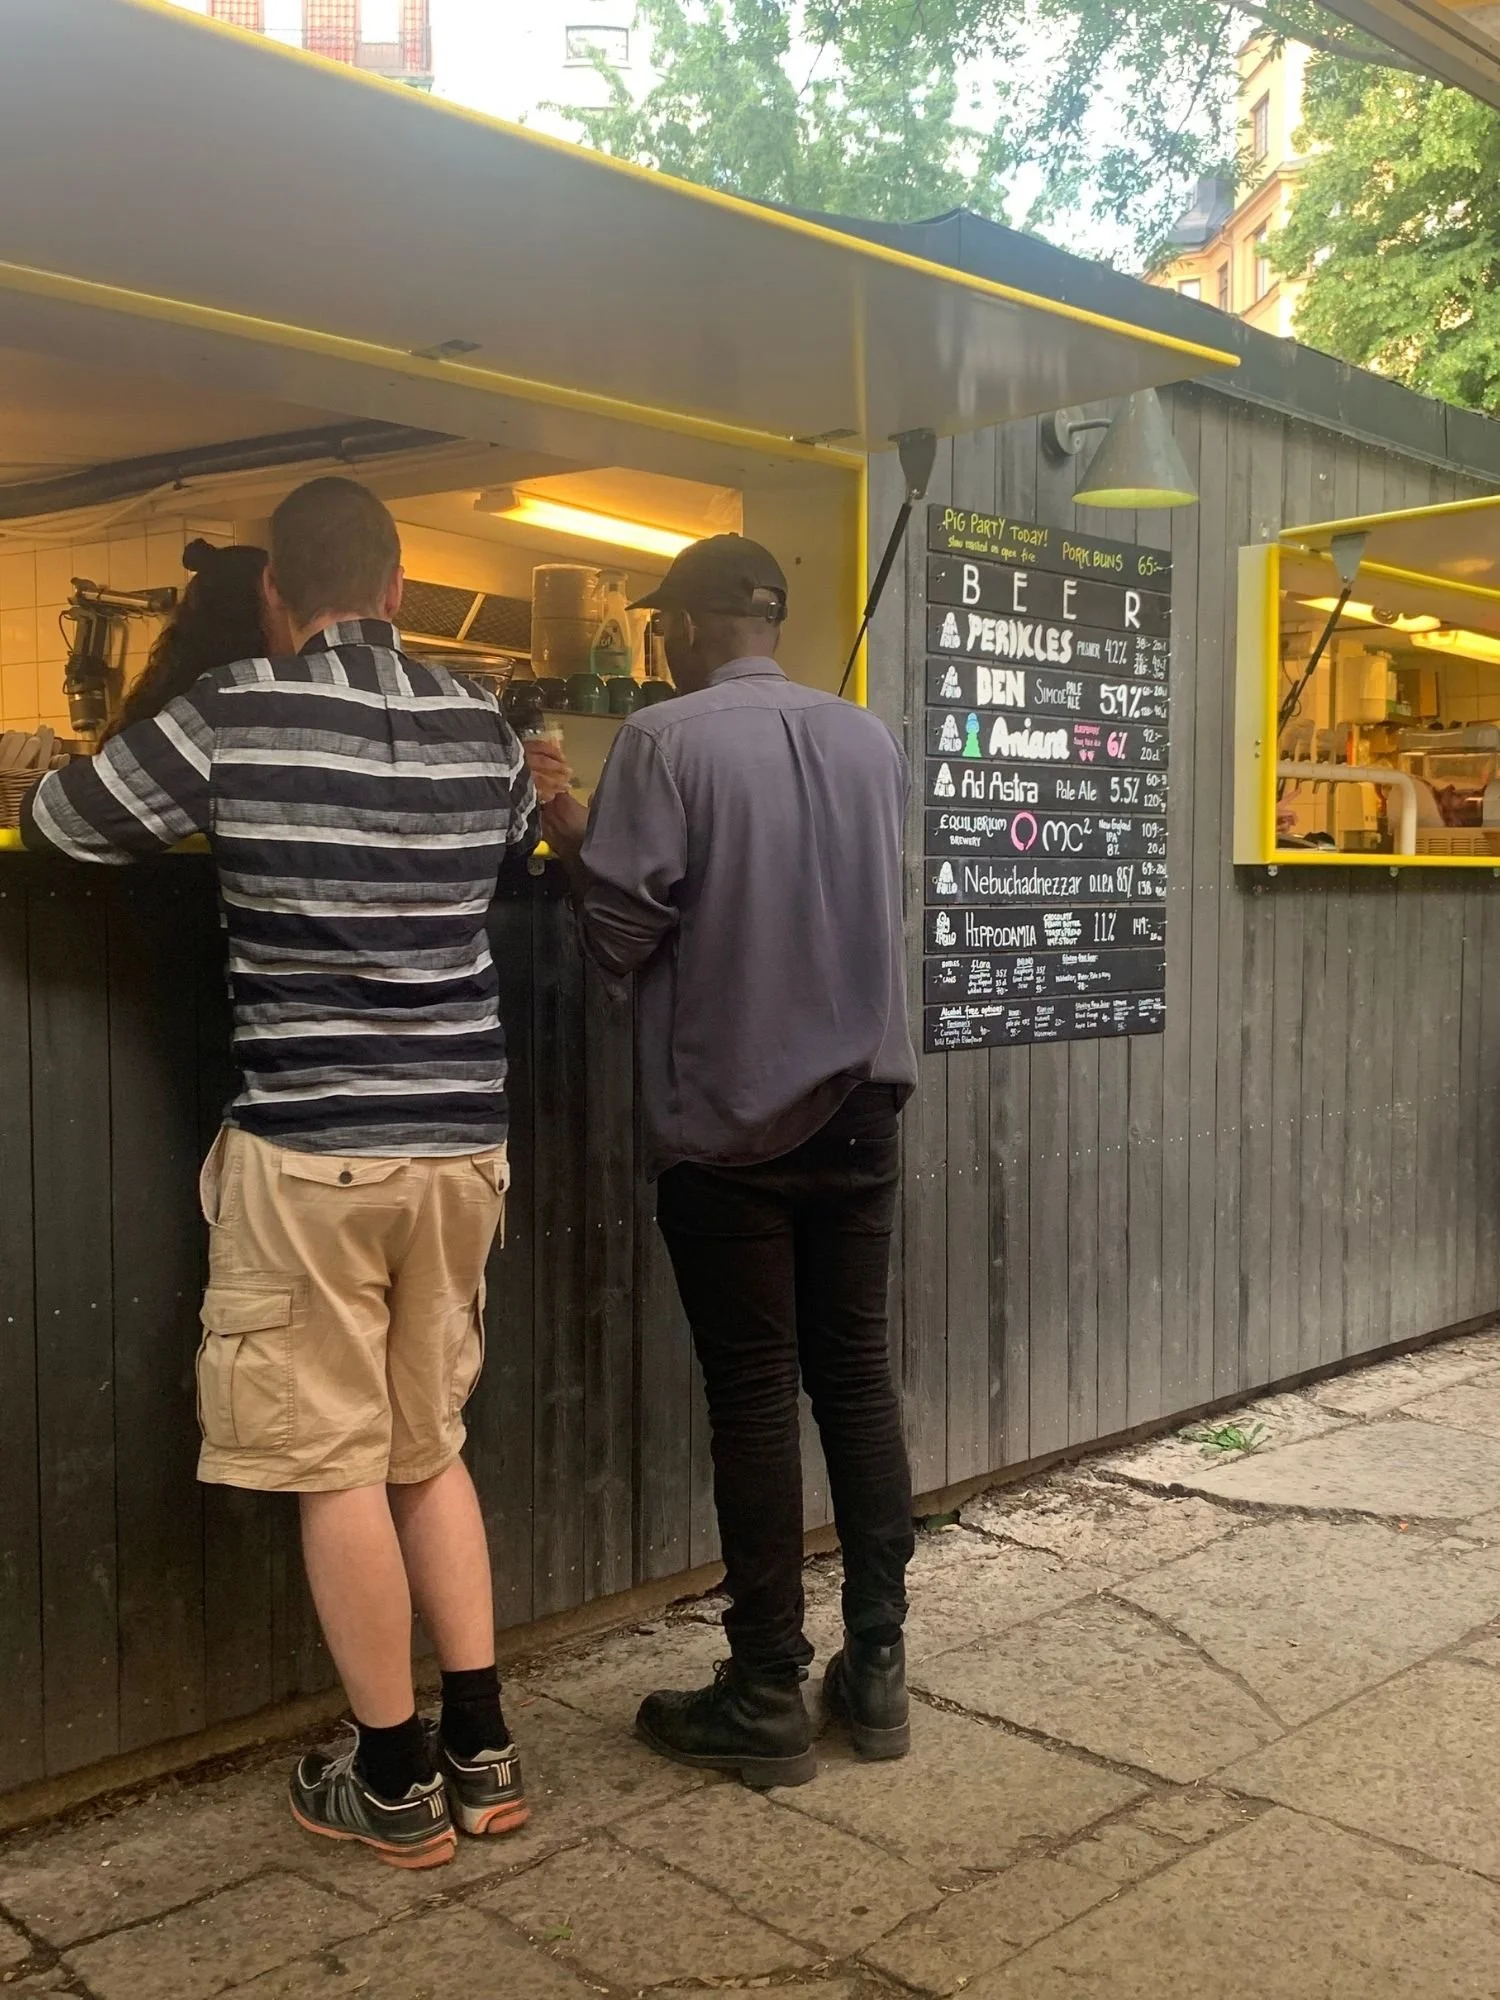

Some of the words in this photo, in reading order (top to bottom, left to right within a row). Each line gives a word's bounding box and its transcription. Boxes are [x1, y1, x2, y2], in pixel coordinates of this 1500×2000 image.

[1063, 541, 1091, 569] PORK
[1093, 551, 1123, 571] BUNS
[967, 612, 1073, 664] PERIKLES
[1066, 681, 1083, 696] PALE
[1067, 695, 1080, 710] ALE
[1100, 683, 1142, 718] 5.9%
[1107, 731, 1128, 760] 6%
[962, 769, 985, 800] Ad
[989, 771, 1039, 803] Astra
[1056, 779, 1075, 801] Pale
[1078, 781, 1097, 801] Ale
[1110, 776, 1140, 804] 5.5%
[1099, 819, 1111, 830] New
[1106, 832, 1118, 843] IPA
[950, 836, 981, 848] BREWERY
[1107, 843, 1120, 857] 8%
[964, 864, 1082, 897] Nebuchadnezzar
[965, 911, 1037, 948] HIPPODAMIA
[1094, 912, 1117, 942] 11%
[941, 1006, 962, 1016] Alcohol
[965, 1005, 979, 1018] free
